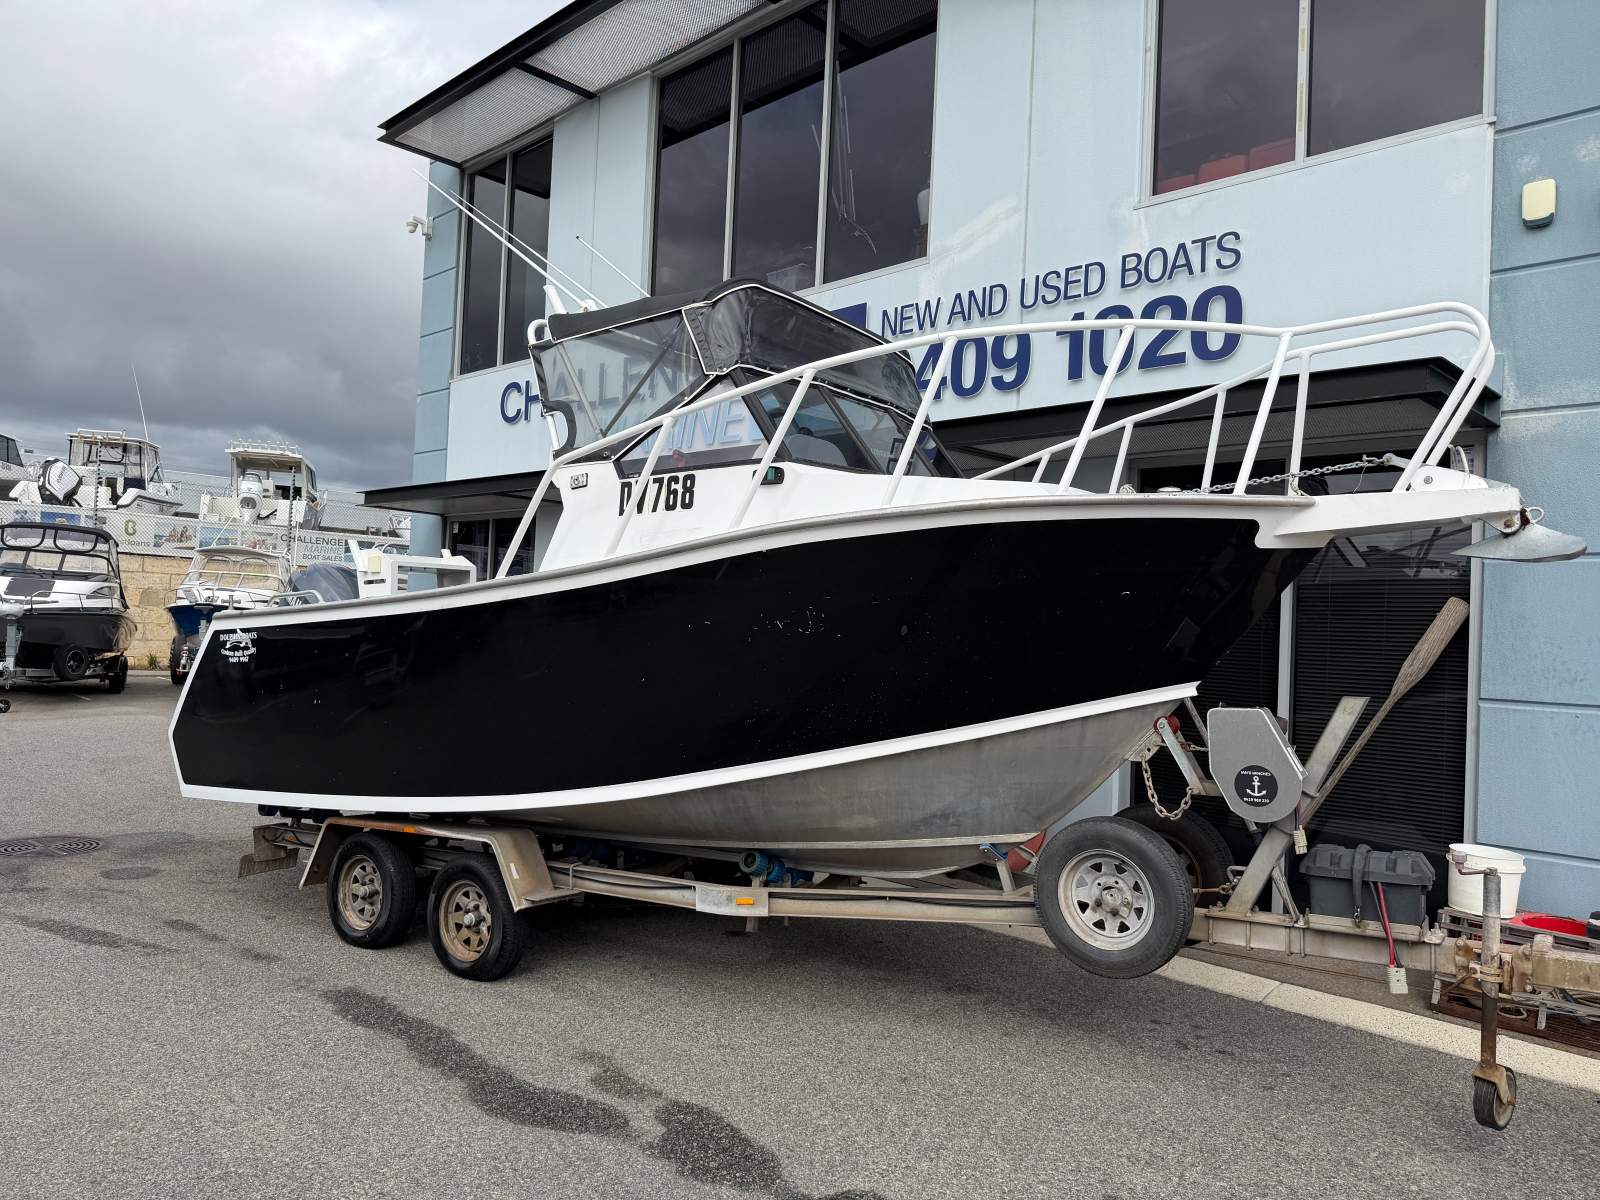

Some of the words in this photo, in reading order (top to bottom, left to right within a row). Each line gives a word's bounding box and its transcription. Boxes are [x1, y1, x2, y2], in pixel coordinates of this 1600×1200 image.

[881, 296, 941, 338] NEW
[947, 283, 1008, 325] AND
[1020, 261, 1106, 310] USED
[1120, 231, 1242, 289] BOATS
[915, 332, 1032, 400] 409
[1055, 285, 1243, 381] 1020
[280, 533, 344, 547] CHALLENGE
[321, 554, 344, 562] SALES
